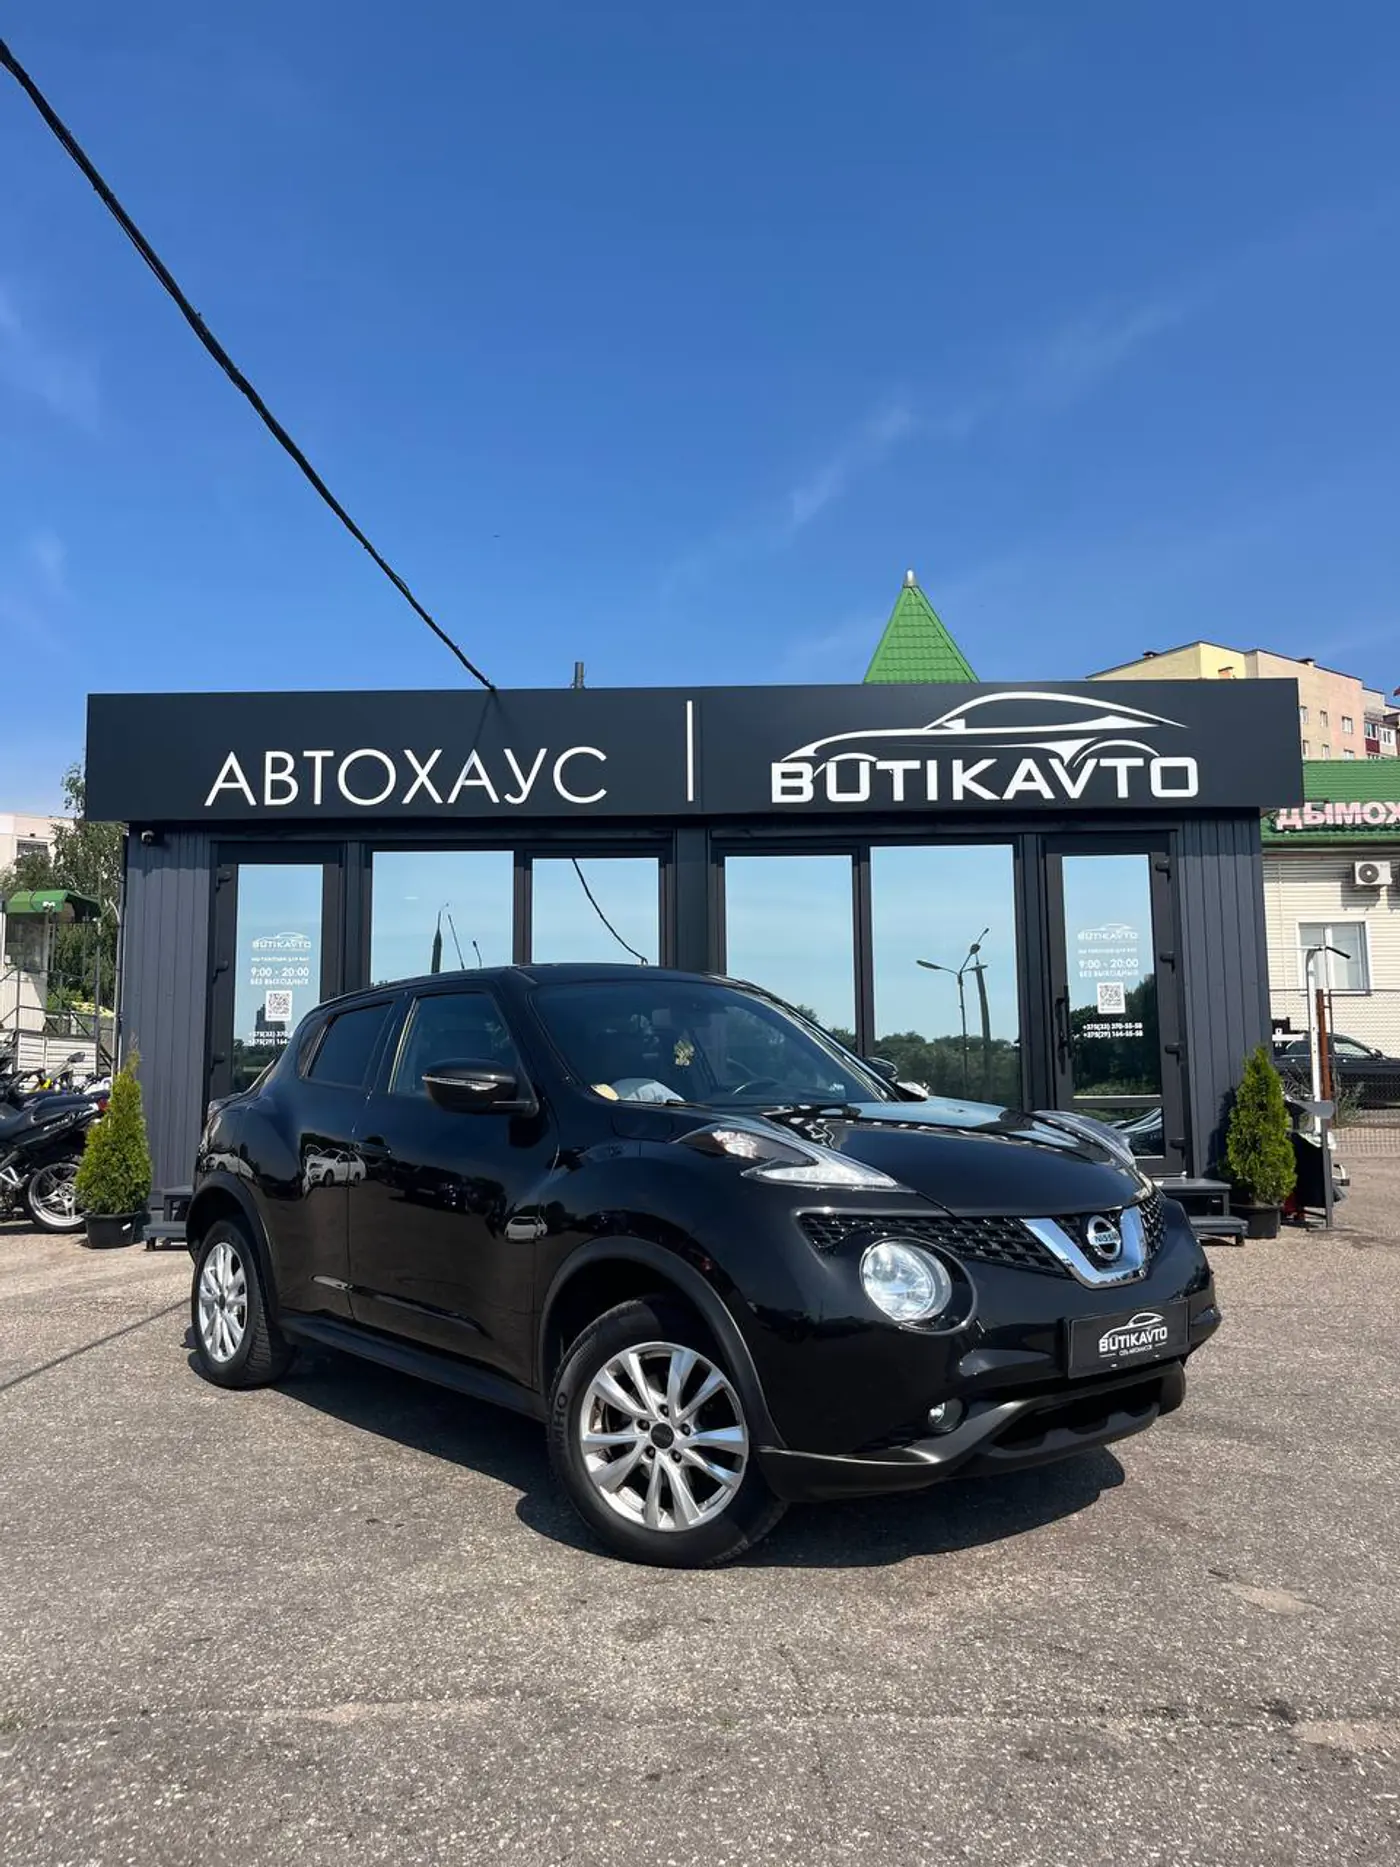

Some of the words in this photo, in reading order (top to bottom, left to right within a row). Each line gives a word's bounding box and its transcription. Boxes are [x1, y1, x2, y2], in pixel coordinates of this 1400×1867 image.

[204, 746, 608, 807] АВТОХАУС
[771, 756, 1199, 803] BUTIKAVTO
[281, 967, 310, 977] 20:00
[1110, 958, 1139, 968] 20:00
[1099, 1326, 1167, 1353] BUTIKAVTO
